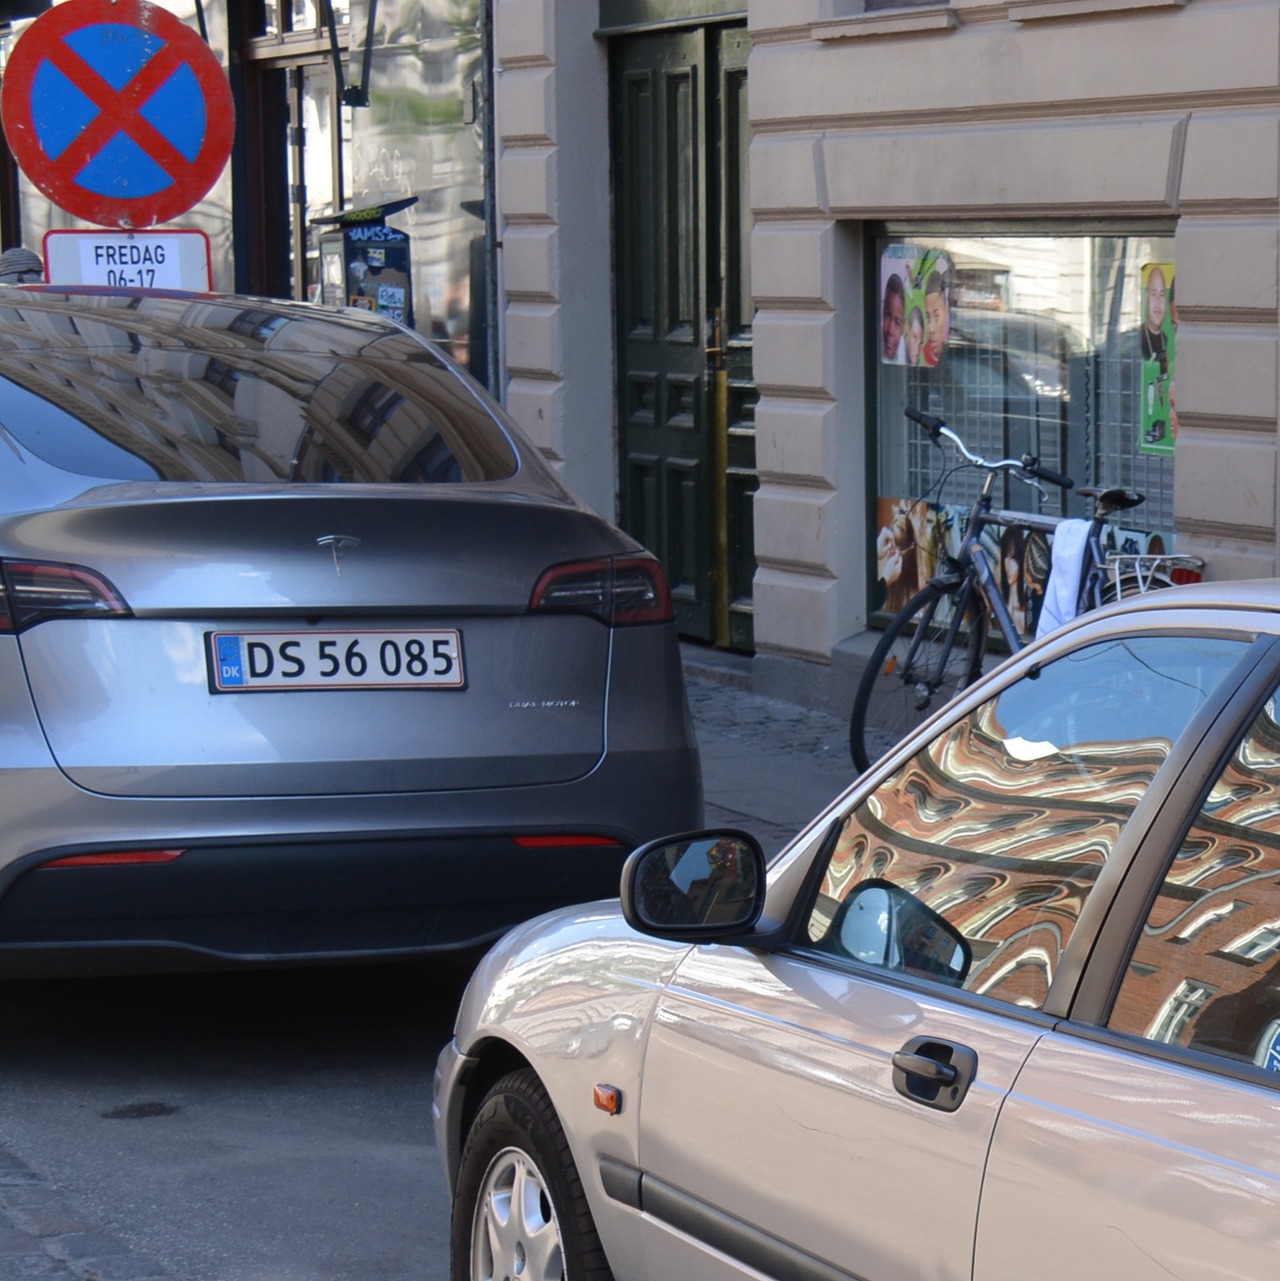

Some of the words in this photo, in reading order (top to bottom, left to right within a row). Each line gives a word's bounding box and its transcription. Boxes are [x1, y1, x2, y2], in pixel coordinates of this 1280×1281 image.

[94, 245, 166, 265] FREDAG
[107, 269, 155, 288] 06-17
[247, 640, 306, 679] DS
[318, 638, 368, 678] 56
[379, 639, 454, 677] 085
[222, 666, 240, 679] DK
